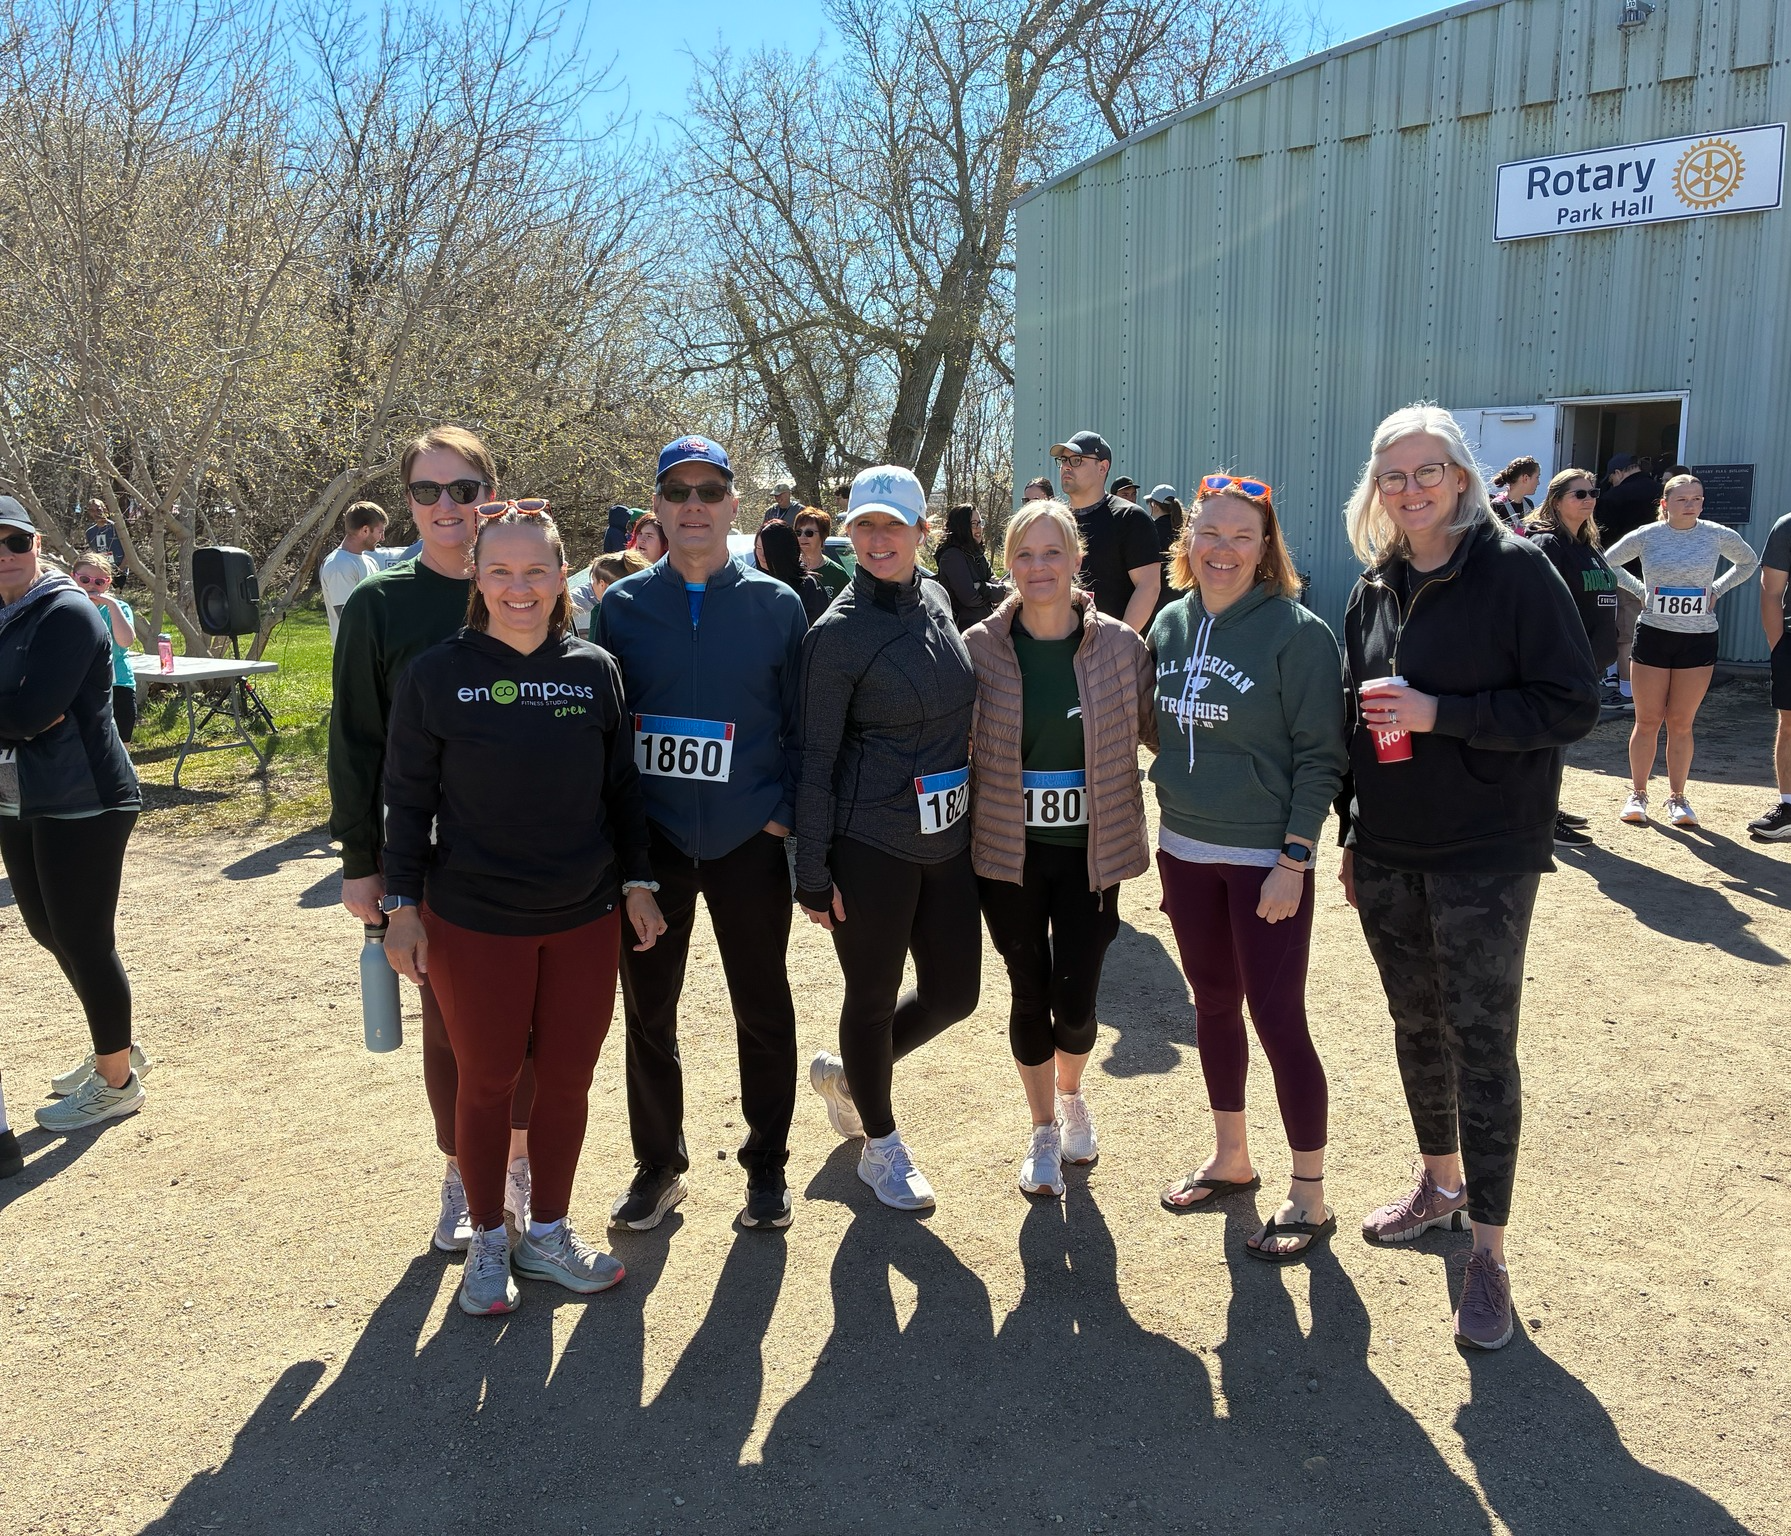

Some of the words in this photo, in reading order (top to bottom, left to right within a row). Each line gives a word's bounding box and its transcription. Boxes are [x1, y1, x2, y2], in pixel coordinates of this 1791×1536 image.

[1527, 158, 1656, 200] Rotary
[1557, 202, 1604, 225] Park
[1611, 195, 1654, 218] Hall
[1657, 596, 1702, 615] 1864
[1183, 655, 1255, 694] AMERICAN
[457, 681, 594, 703] encompass
[554, 705, 587, 718] crew
[1160, 696, 1229, 721] TROPHIES
[641, 734, 723, 777] 1860
